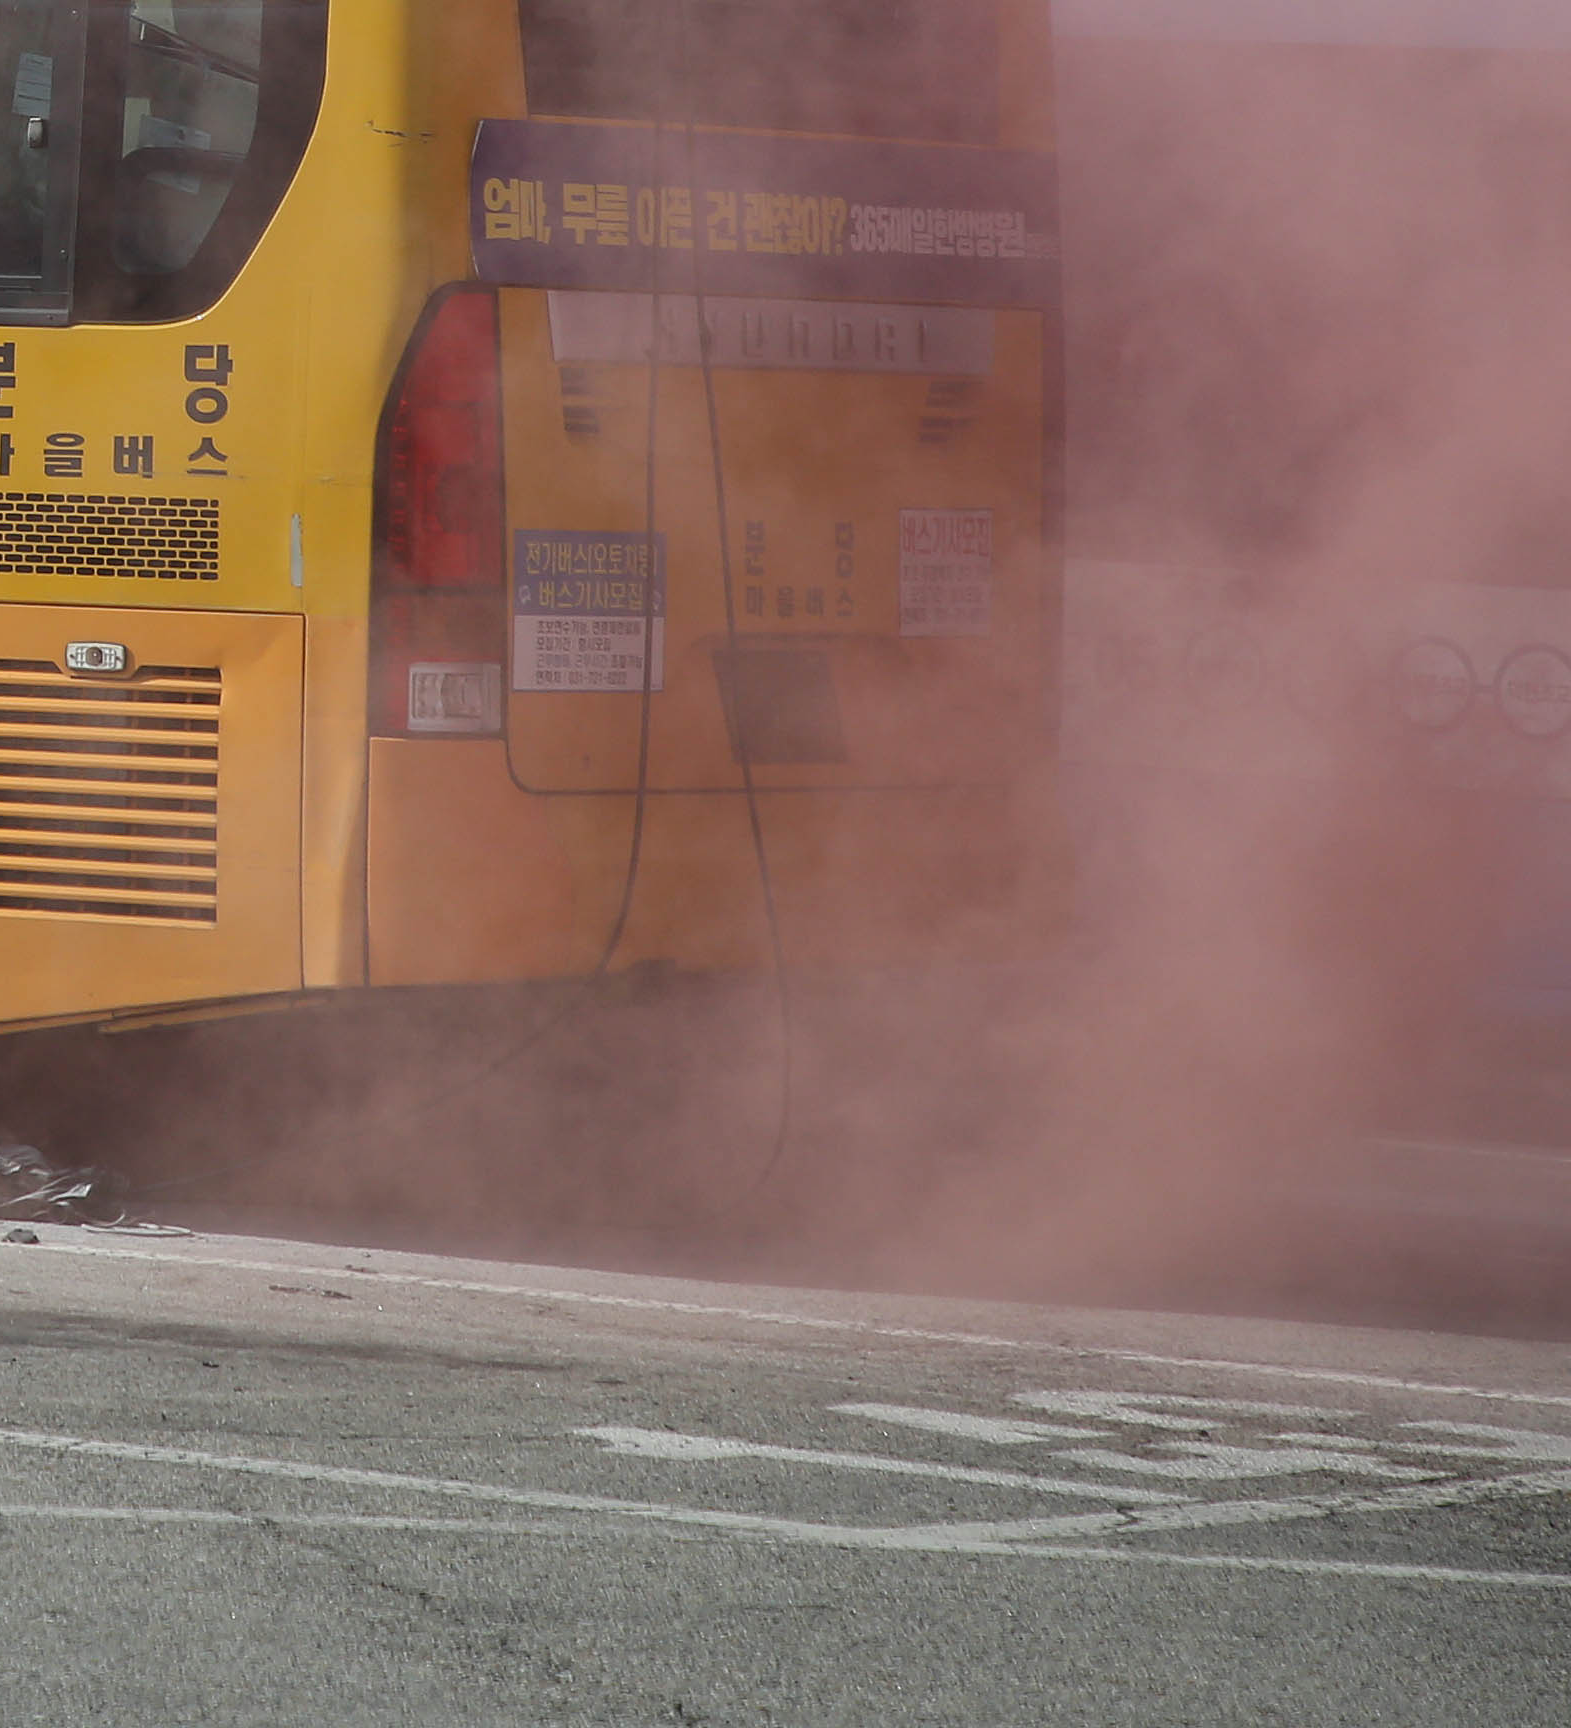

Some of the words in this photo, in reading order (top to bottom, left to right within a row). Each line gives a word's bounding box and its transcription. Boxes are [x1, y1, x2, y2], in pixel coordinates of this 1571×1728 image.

[562, 183, 629, 246] 무릎
[706, 190, 740, 252] 건
[539, 581, 643, 610] 버스기사모집
